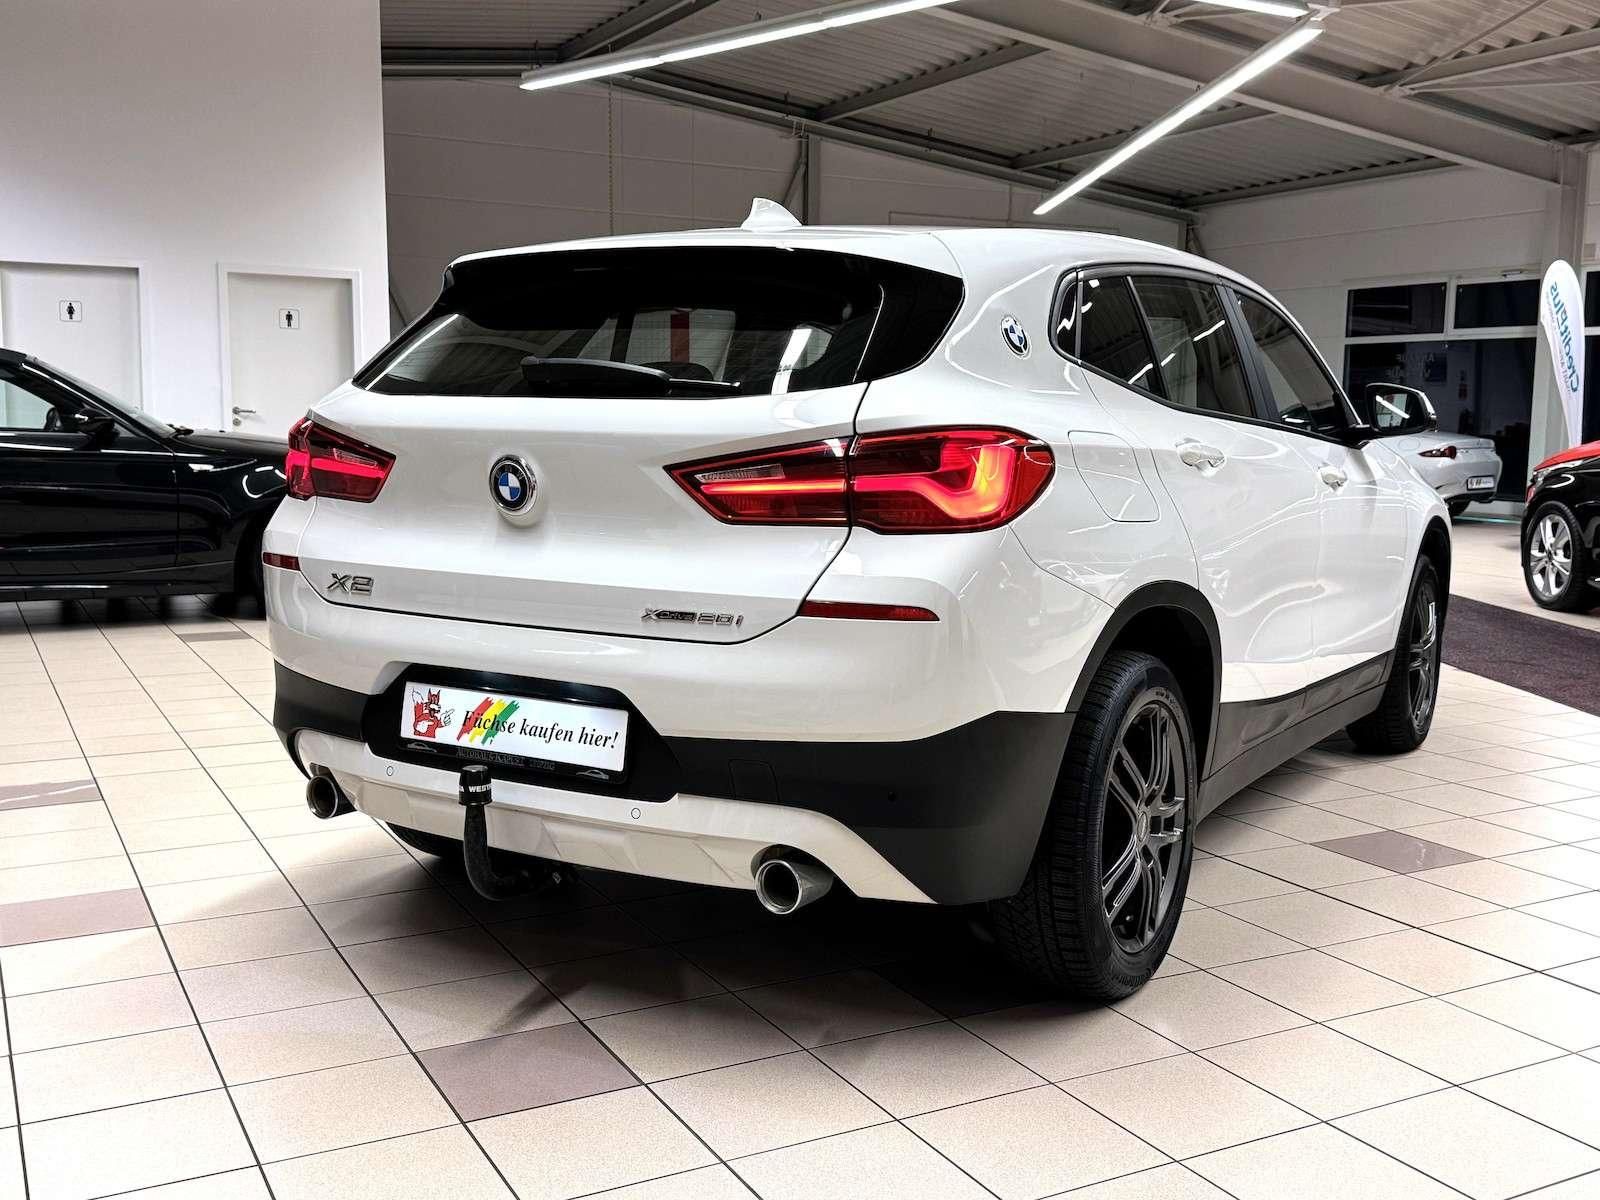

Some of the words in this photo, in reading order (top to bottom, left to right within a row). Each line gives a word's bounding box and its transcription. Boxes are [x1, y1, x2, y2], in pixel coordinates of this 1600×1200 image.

[326, 573, 374, 596] X2
[463, 709, 516, 735] Füchse
[519, 718, 574, 744] kaufen
[578, 726, 619, 749] hier!
